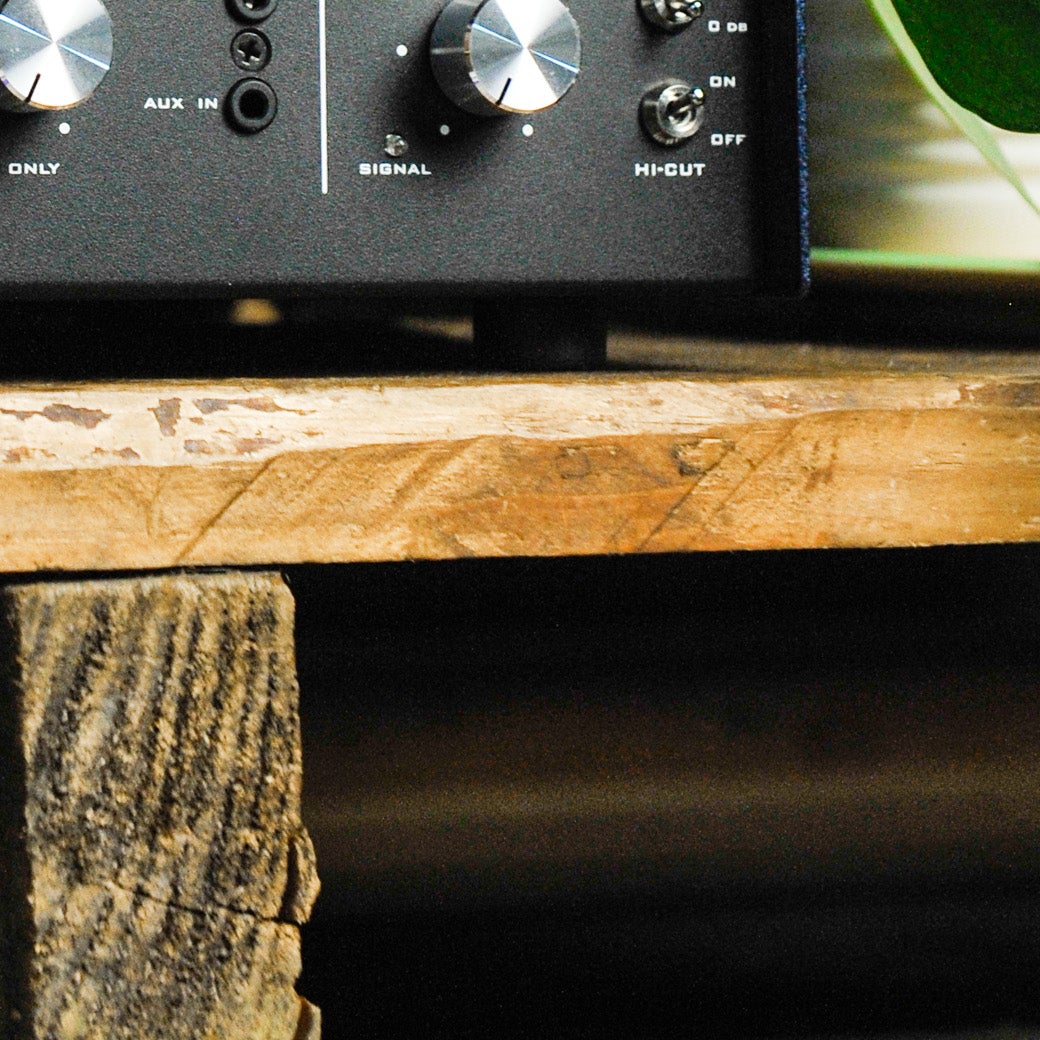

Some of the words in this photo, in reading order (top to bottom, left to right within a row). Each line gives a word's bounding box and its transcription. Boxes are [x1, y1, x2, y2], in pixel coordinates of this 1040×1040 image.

[709, 74, 737, 89] ON
[143, 97, 186, 111] AUX
[197, 97, 219, 111] IN
[710, 132, 747, 147] OFF
[7, 161, 62, 176] ONLY
[358, 162, 433, 177] SIGNAL
[634, 161, 707, 178] HI-CUT
